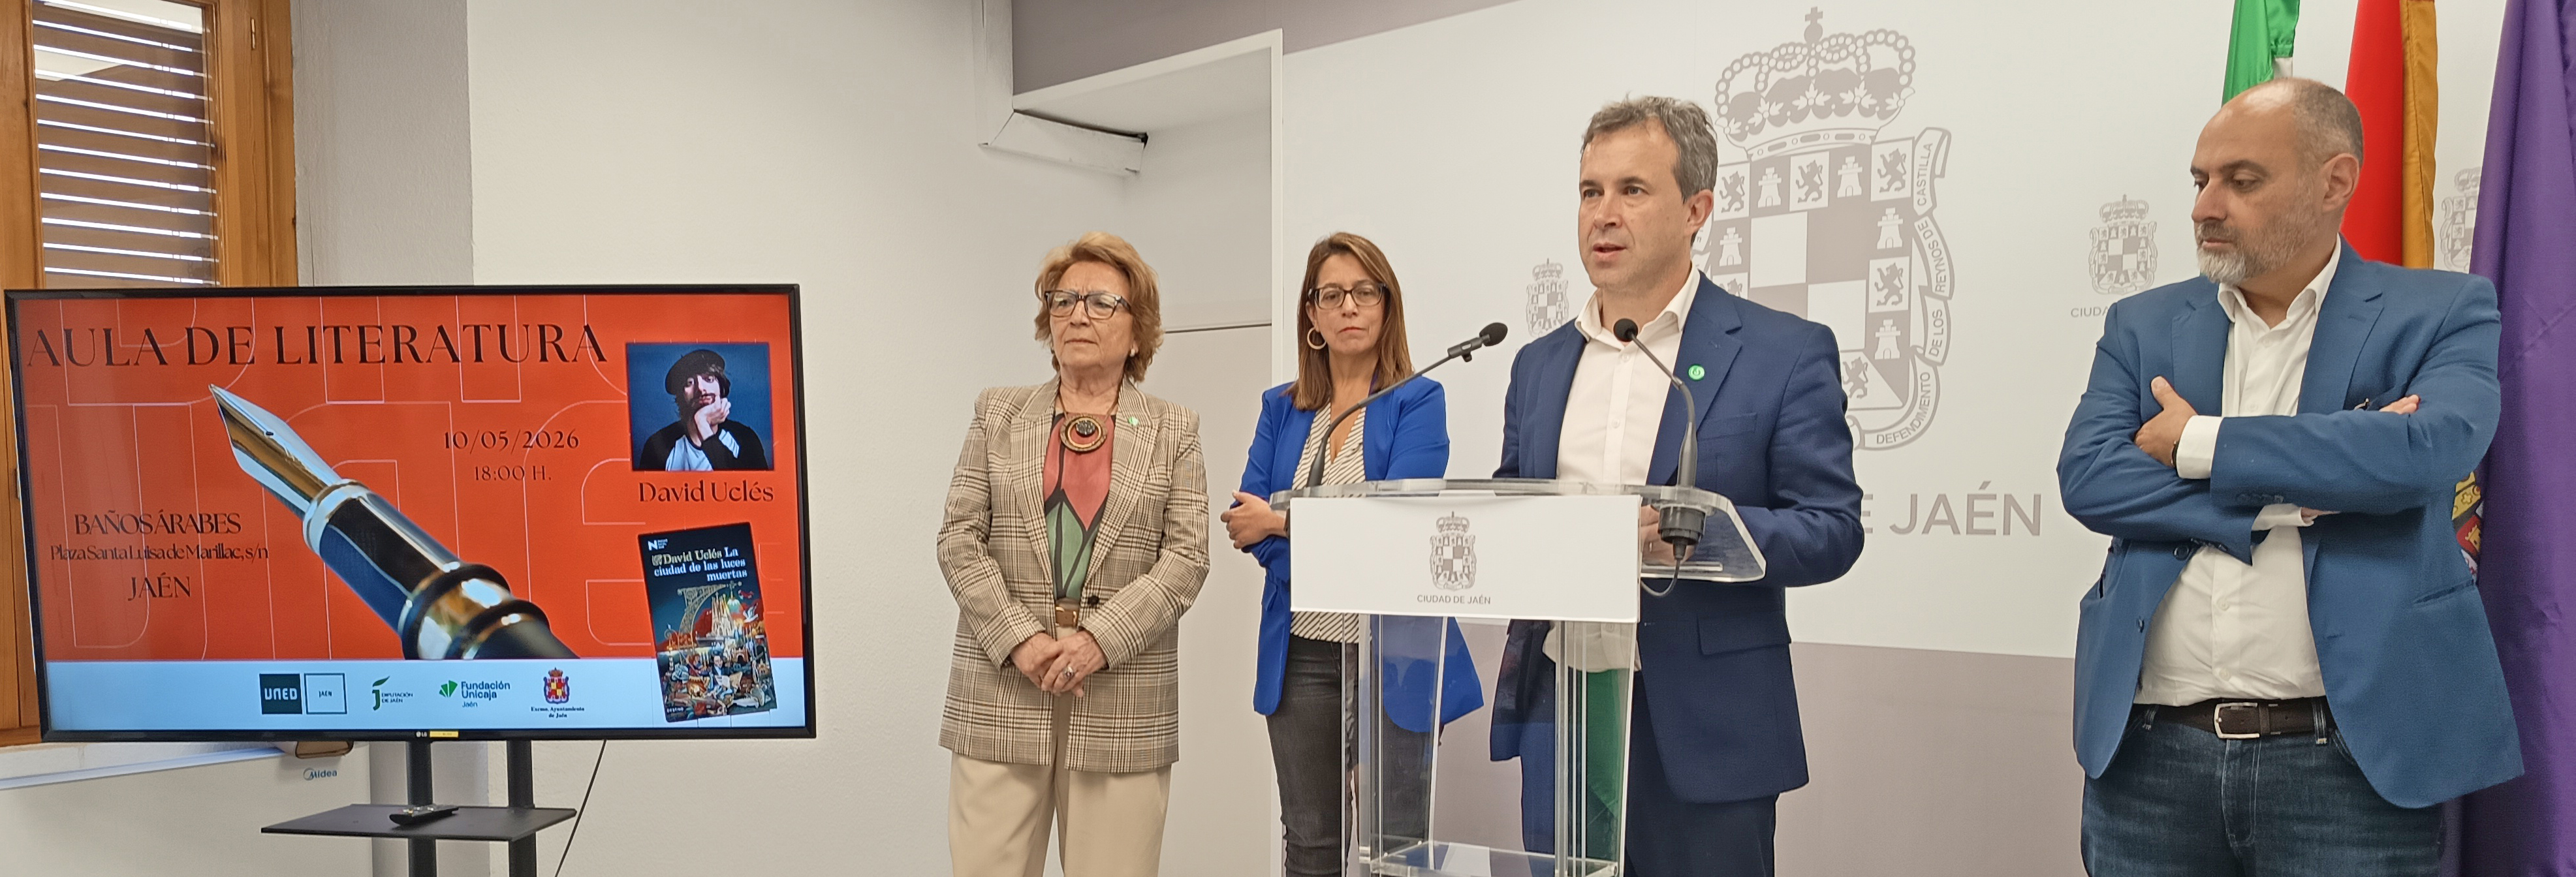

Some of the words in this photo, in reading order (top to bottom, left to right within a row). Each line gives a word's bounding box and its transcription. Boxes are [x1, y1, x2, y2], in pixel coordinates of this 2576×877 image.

[1916, 142, 1934, 207] CASTILLA
[1917, 219, 1934, 241] DE
[1928, 239, 1947, 294] REYNOS
[1932, 309, 1944, 336] LOS
[2070, 306, 2109, 318] CIUDA
[27, 327, 169, 367] AULA
[185, 326, 255, 365] DE
[274, 322, 608, 365] LITERATURA
[1928, 338, 1943, 358] DE
[1876, 371, 1931, 445] DEFENDIMENTO
[444, 429, 580, 455] 10/05/2026
[474, 465, 525, 482] 18:00
[532, 465, 552, 482] H.
[638, 479, 705, 503] David
[710, 480, 774, 503] Uclés
[1889, 480, 2042, 536] JAÉN
[74, 510, 153, 535] BAÑOS
[154, 509, 242, 534] ÁRABES
[50, 544, 86, 561] Plaza
[87, 545, 128, 561] Santa
[129, 545, 165, 561] Luisa
[166, 544, 185, 560] de
[185, 543, 244, 562] Marillac,
[245, 543, 269, 564] s/n
[663, 551, 693, 565] David
[695, 548, 723, 561] Uclés
[723, 546, 739, 557] La
[653, 562, 687, 577] ciudad
[689, 561, 701, 573] de
[703, 560, 719, 571] las
[721, 558, 746, 570] luces
[706, 569, 748, 582] muertas
[128, 572, 191, 602] JAÉN
[1417, 594, 1451, 604] CIUDAD
[1453, 595, 1465, 604] DE
[1467, 593, 1491, 605] JAÉN
[264, 687, 298, 701] UNED
[461, 680, 510, 690] Fundación
[461, 690, 497, 701] Unicaja
[306, 769, 338, 780] Midea
